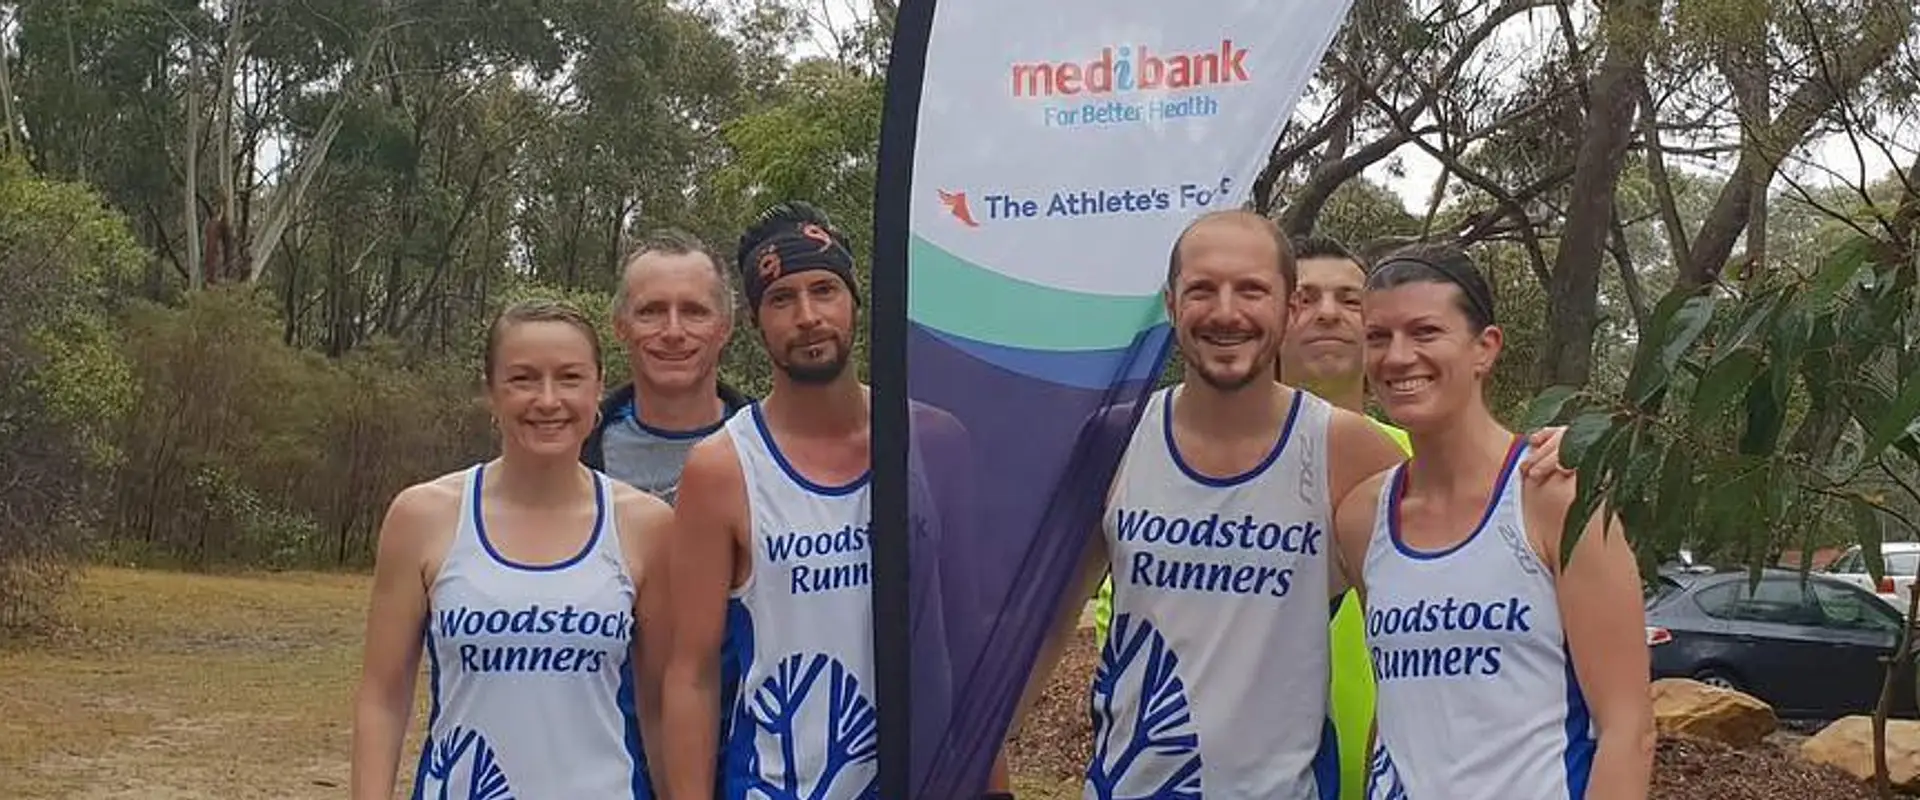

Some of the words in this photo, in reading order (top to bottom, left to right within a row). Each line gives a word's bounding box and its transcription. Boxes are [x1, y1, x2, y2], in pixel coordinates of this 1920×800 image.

[1013, 40, 1250, 96] medibank
[1044, 107, 1078, 126] For
[1083, 102, 1142, 124] Better
[1149, 95, 1218, 121] Health
[985, 195, 1038, 219] The
[1047, 189, 1169, 217] Athlete's
[1180, 177, 1231, 208] Fot
[766, 522, 875, 562] Woodst
[1117, 508, 1321, 555] Woodstock
[791, 562, 869, 594] Runn
[1131, 551, 1293, 598] Runners
[439, 604, 631, 639] Woodstock
[1369, 597, 1531, 637] oodstock
[461, 644, 607, 673] Runners
